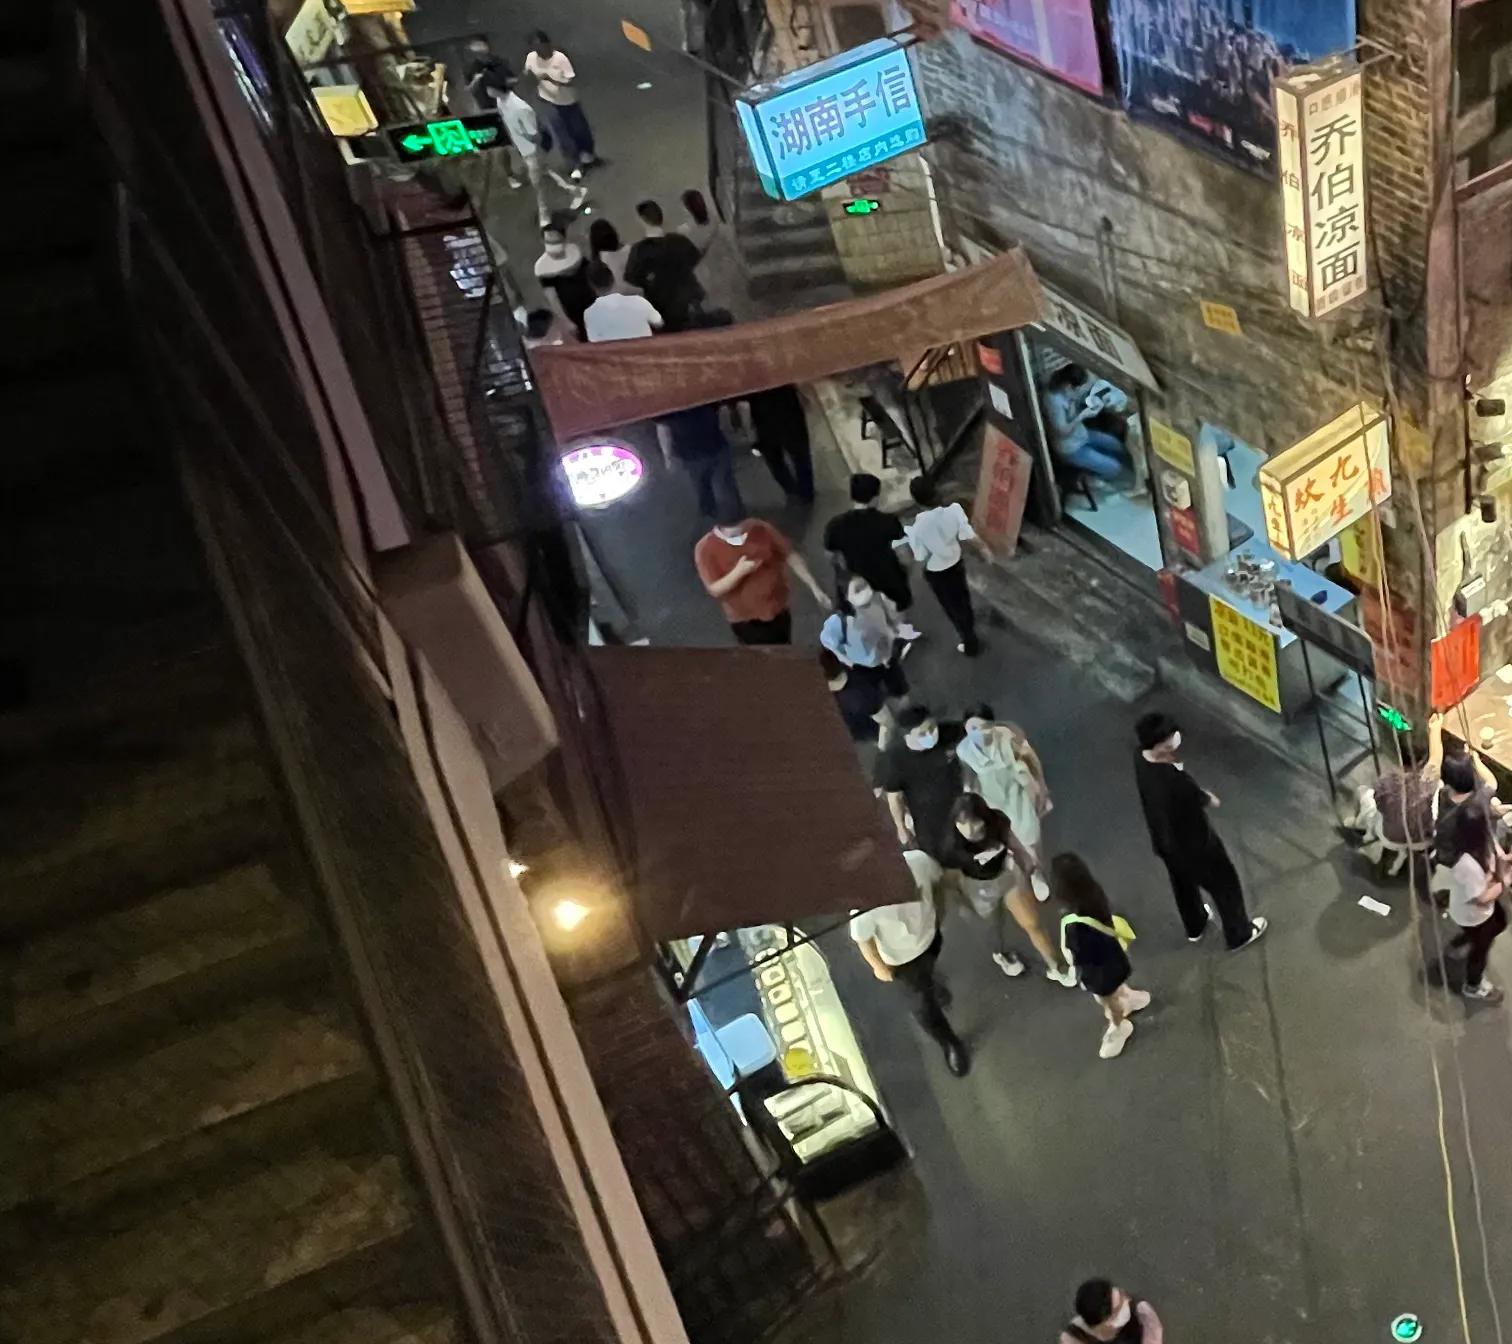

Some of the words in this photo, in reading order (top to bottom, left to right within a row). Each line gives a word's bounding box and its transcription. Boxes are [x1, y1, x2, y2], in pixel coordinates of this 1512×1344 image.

[769, 64, 912, 160] 湖南手信
[1310, 113, 1360, 292] 乔伯凉面
